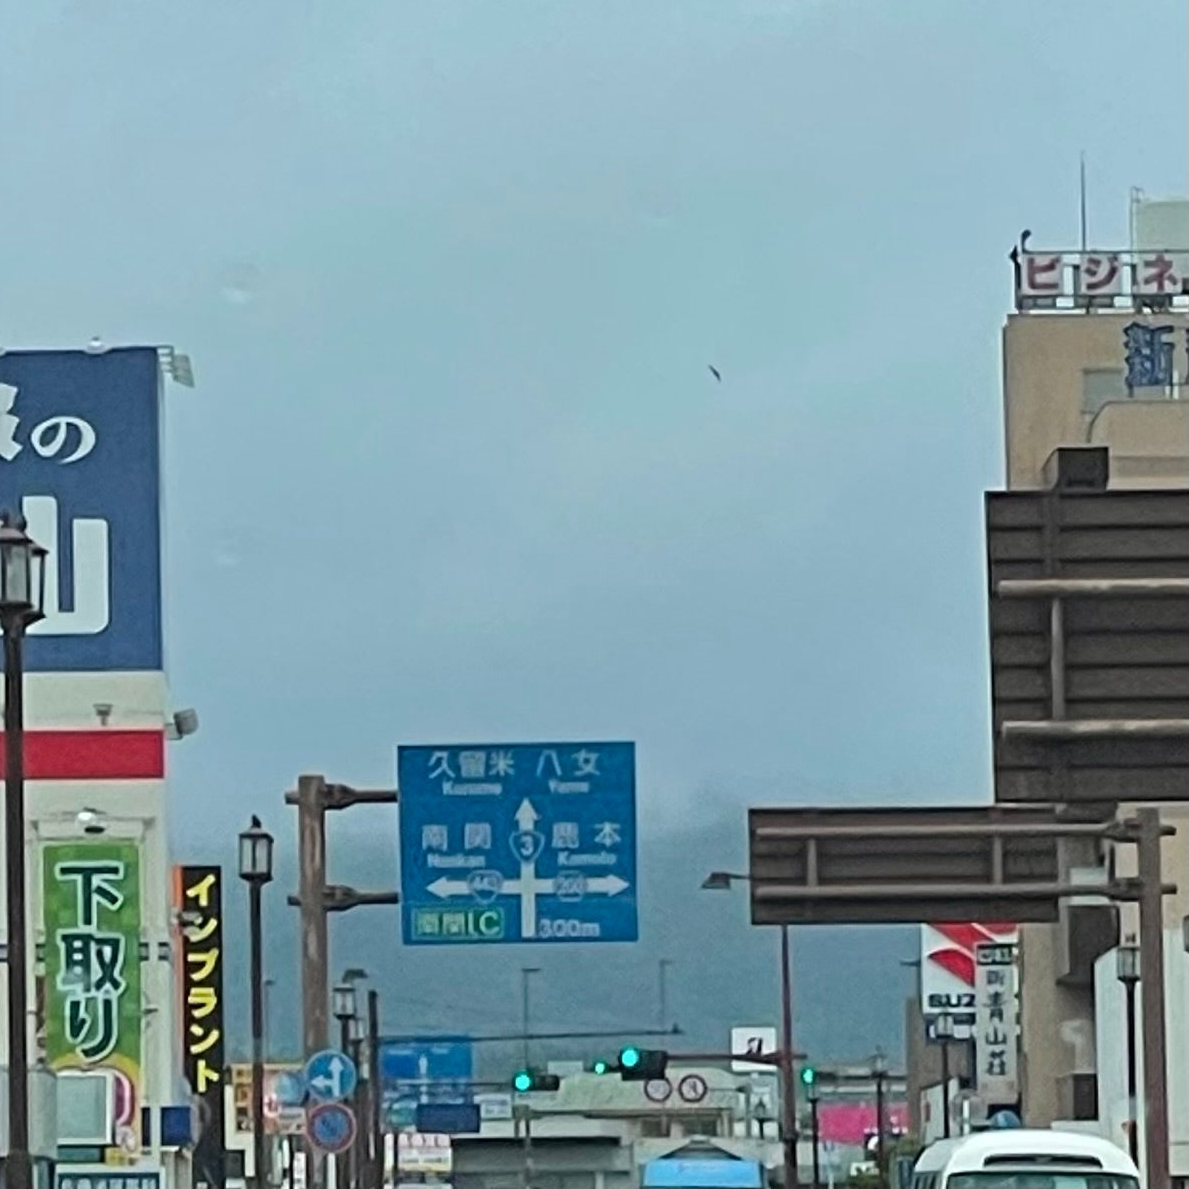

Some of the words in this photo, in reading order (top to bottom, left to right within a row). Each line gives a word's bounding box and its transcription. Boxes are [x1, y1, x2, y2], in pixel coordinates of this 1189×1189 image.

[1026, 255, 1179, 291] ビジネ
[428, 750, 515, 779] 久留米
[536, 749, 601, 777] 八女
[519, 835, 534, 856] 3
[539, 918, 600, 938] 300m
[56, 862, 126, 1062] 下取り
[185, 873, 221, 1094] インプラント
